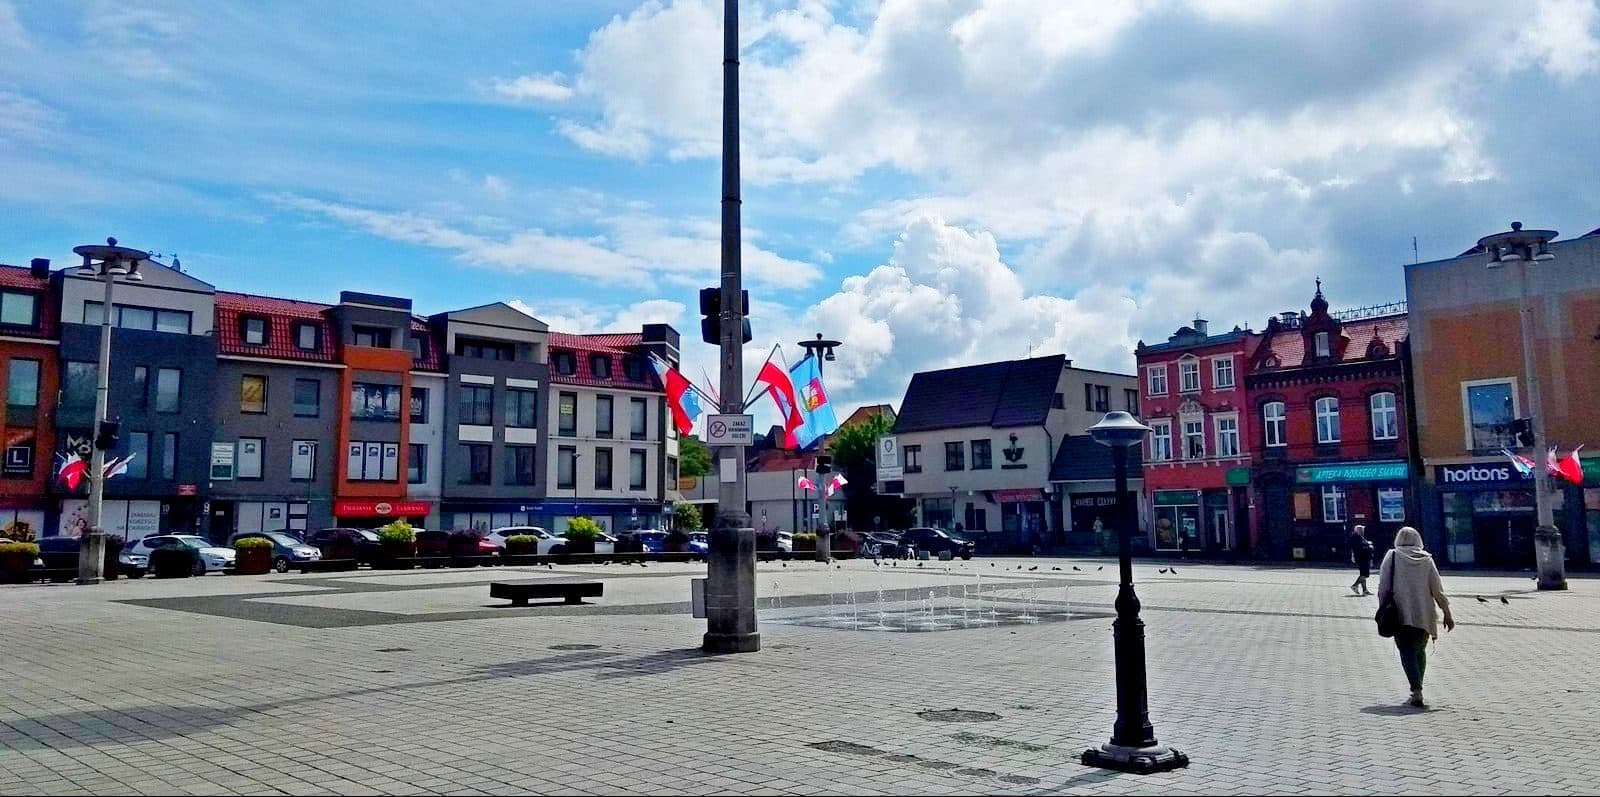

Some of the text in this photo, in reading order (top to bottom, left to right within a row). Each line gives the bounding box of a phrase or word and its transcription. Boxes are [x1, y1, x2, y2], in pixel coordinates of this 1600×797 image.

[13, 450, 23, 463] L
[1443, 467, 1509, 482] hortons
[813, 503, 820, 513] P
